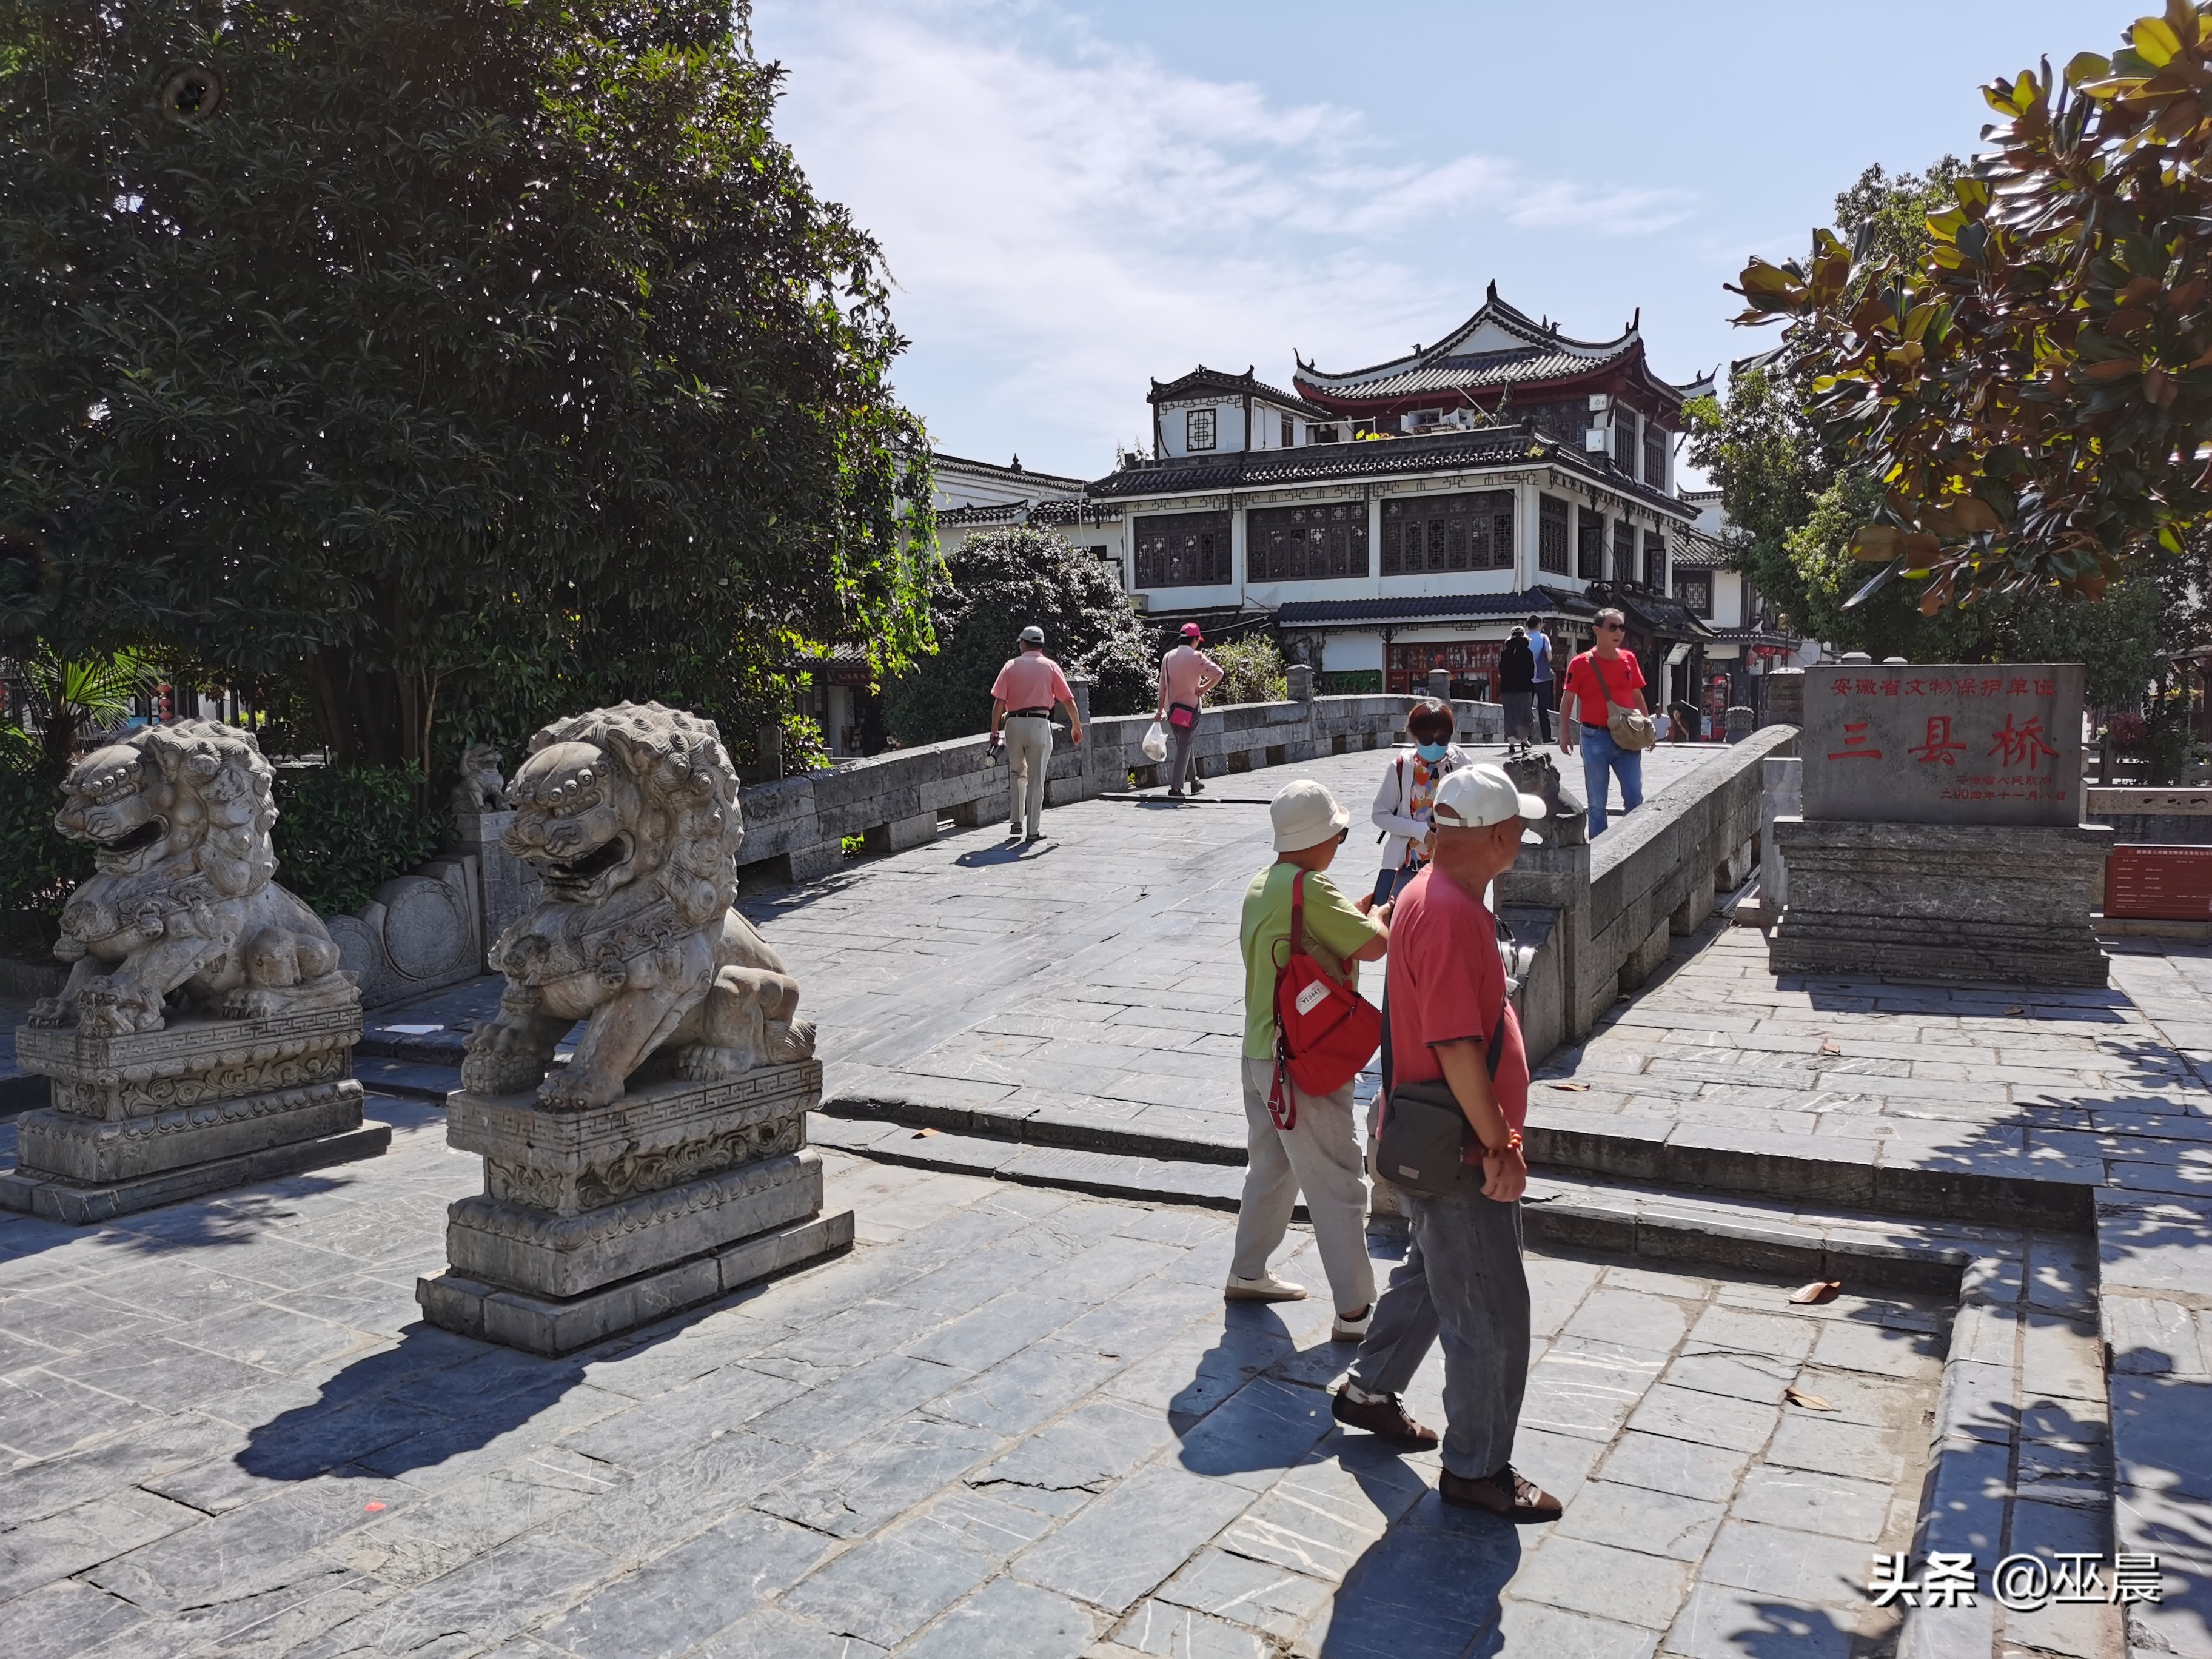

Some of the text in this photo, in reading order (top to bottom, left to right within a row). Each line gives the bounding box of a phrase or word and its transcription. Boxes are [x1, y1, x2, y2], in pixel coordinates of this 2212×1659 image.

[1831, 678, 2055, 697] 安徽省文物保护单位
[1828, 712, 2059, 771] 三县桥
[1956, 776, 2053, 786] 安徽省人民政府
